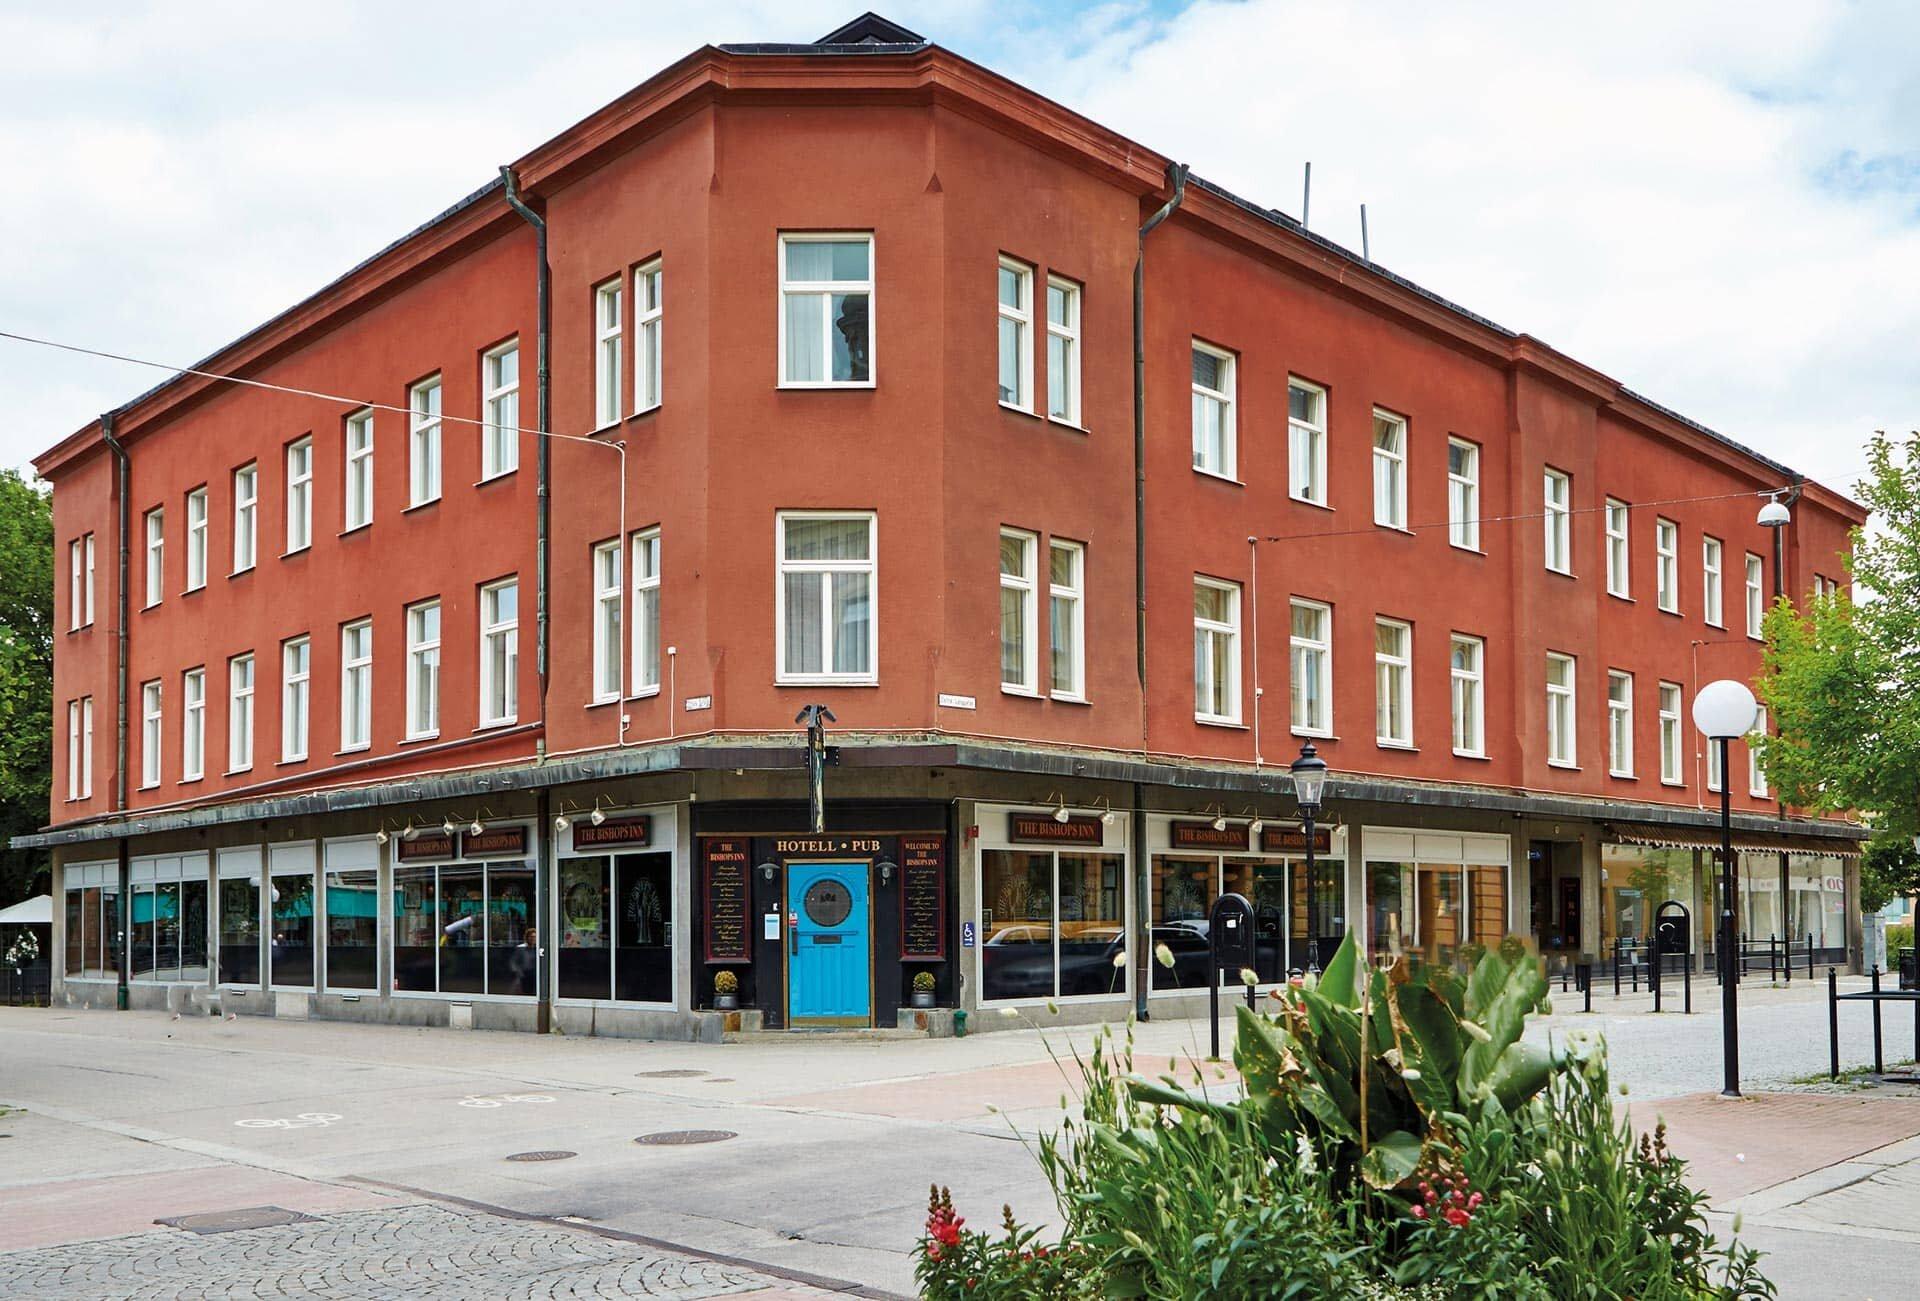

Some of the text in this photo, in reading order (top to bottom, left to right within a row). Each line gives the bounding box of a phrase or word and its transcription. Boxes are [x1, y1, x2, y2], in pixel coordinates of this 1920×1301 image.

[581, 823, 644, 841] THE BISHOPS INN
[1019, 822, 1095, 837] THE BISHOPS INN
[1180, 828, 1243, 843] THE BISHOPS INN
[720, 843, 733, 852] THE
[777, 840, 881, 852] HOTELL PUB
